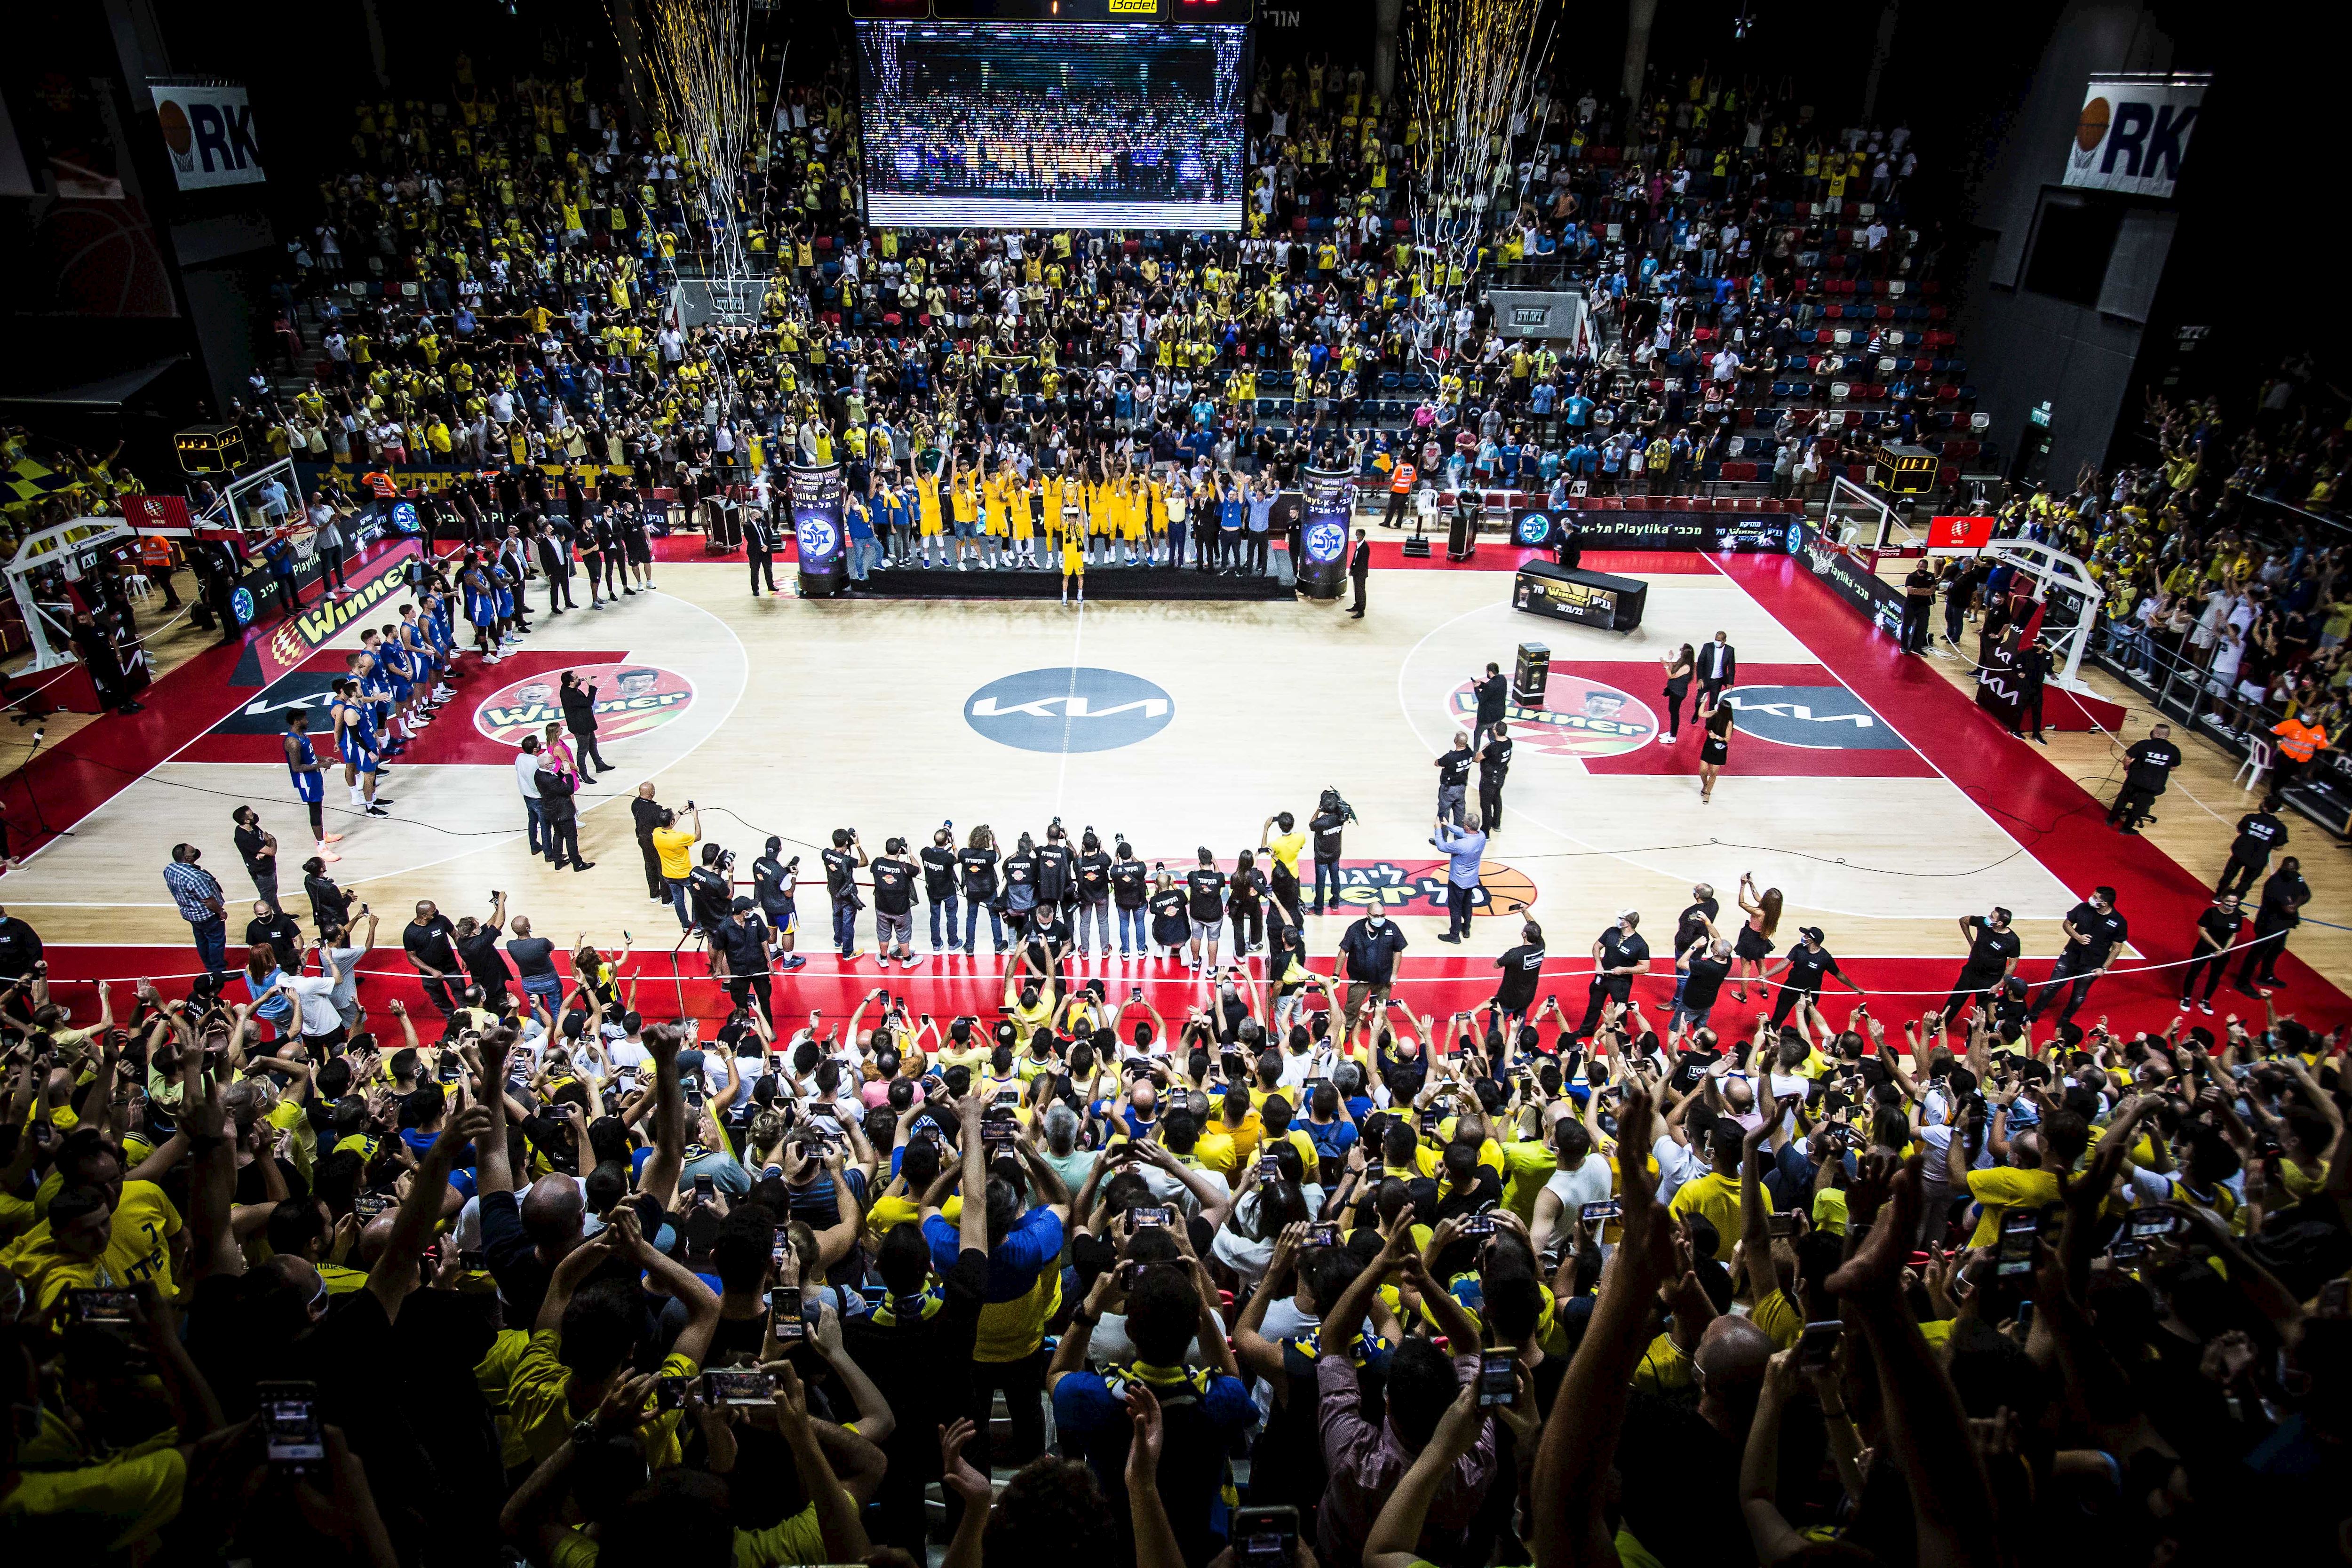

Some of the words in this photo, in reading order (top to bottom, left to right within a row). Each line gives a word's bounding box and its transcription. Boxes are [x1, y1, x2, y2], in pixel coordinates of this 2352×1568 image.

[1111, 0, 1156, 10] Bodet
[822, 491, 840, 500] מכבי
[356, 523, 376, 536] Winner
[1616, 523, 1669, 536] Playtika
[1675, 526, 1702, 535] מכבי
[84, 554, 96, 568] A1
[293, 552, 321, 576] Playtik
[1831, 563, 1854, 588] laytika
[1533, 584, 1544, 594] סל
[1547, 586, 1589, 605] Winner
[1591, 595, 1611, 610] גביע
[2068, 599, 2080, 612] A6
[1557, 603, 1584, 616] 2021/22
[487, 692, 686, 725] Winer
[755, 862, 772, 875] תקשורת
[878, 865, 900, 874] תקשורת
[1156, 896, 1178, 908] תקשורת
[189, 1001, 203, 1015] PUMA
[142, 1222, 159, 1244] 7
